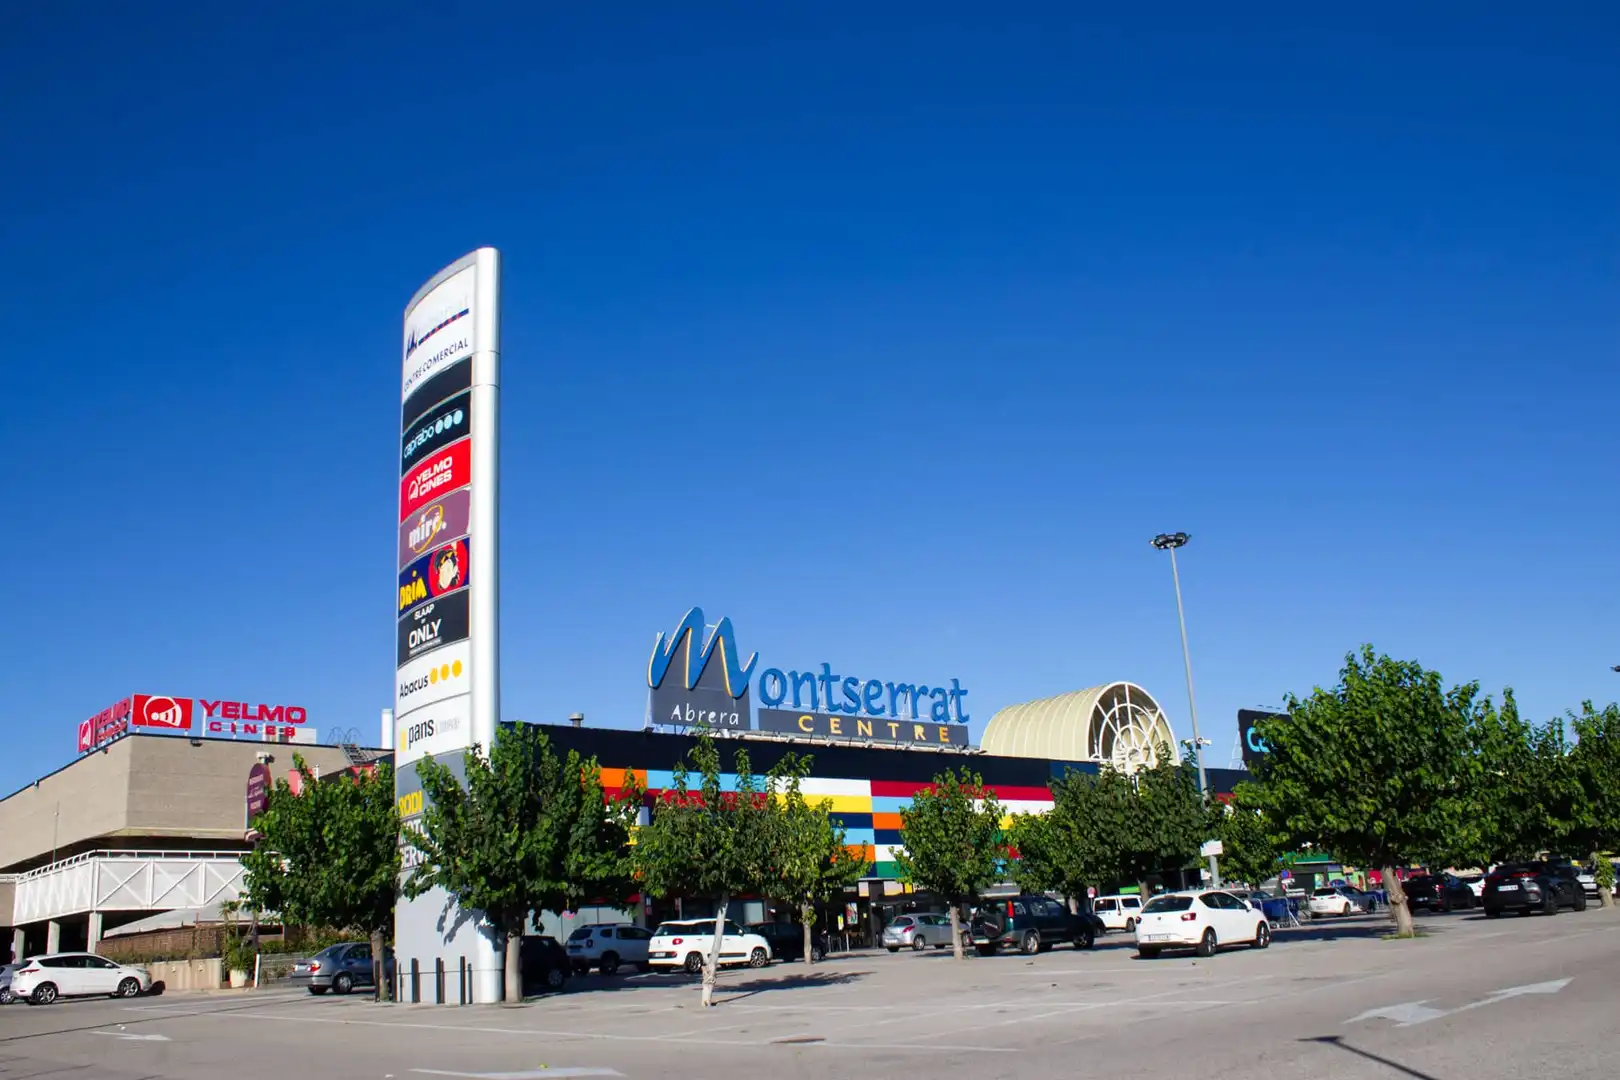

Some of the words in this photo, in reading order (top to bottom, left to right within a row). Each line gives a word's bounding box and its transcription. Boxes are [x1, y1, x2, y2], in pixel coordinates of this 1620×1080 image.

[422, 338, 469, 372] COMERCIAL
[416, 456, 452, 485] YELMO
[419, 469, 452, 496] CINES
[413, 603, 435, 620] SLAAP
[408, 618, 441, 648] ONLY
[648, 606, 969, 723] Montserrat
[399, 675, 428, 698] Abacus
[199, 699, 307, 724] YELMO
[670, 702, 740, 726] Abrera
[209, 721, 295, 737] CINES
[408, 719, 434, 750] pans
[797, 714, 951, 743] CENTRE
